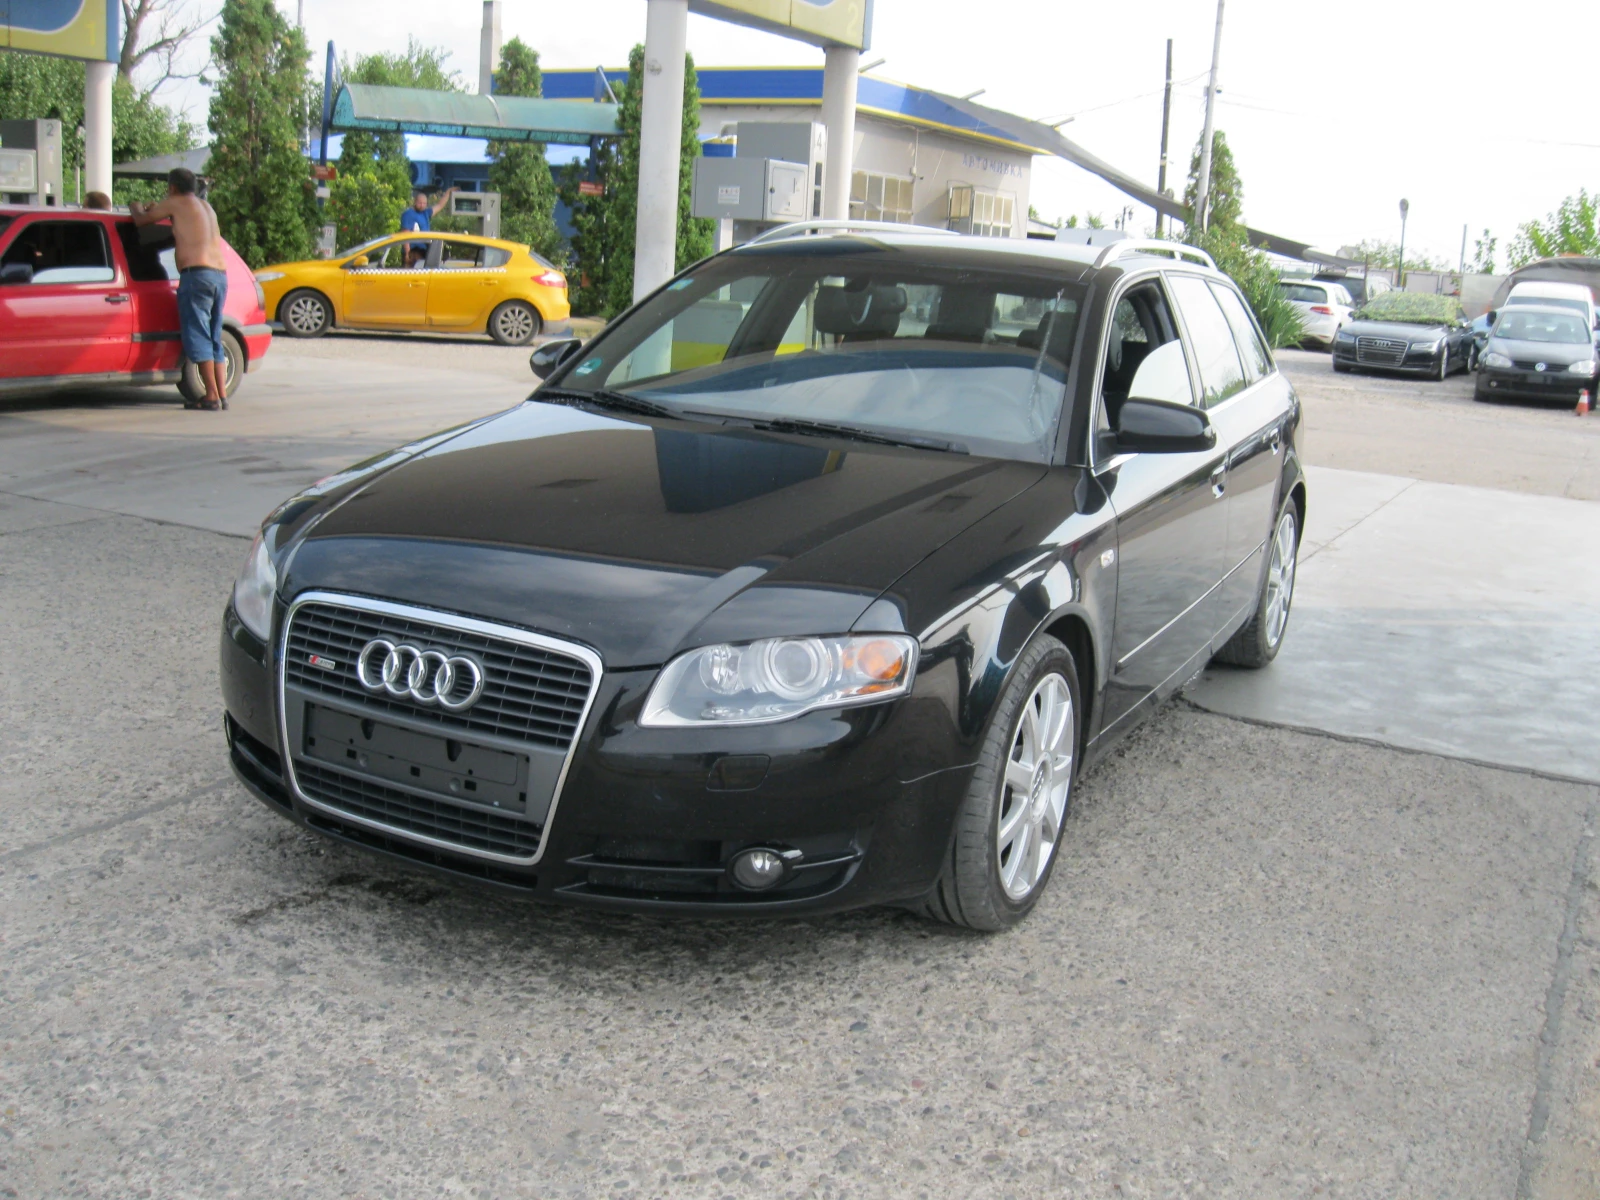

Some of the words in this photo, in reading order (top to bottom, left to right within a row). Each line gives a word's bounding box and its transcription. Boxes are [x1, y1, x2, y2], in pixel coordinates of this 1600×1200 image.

[846, 2, 859, 38] 2
[86, 22, 96, 46] 1
[46, 123, 54, 136] 2
[816, 131, 823, 150] 4
[962, 153, 1023, 178] АВТОМИВКА
[490, 199, 496, 208] 7
